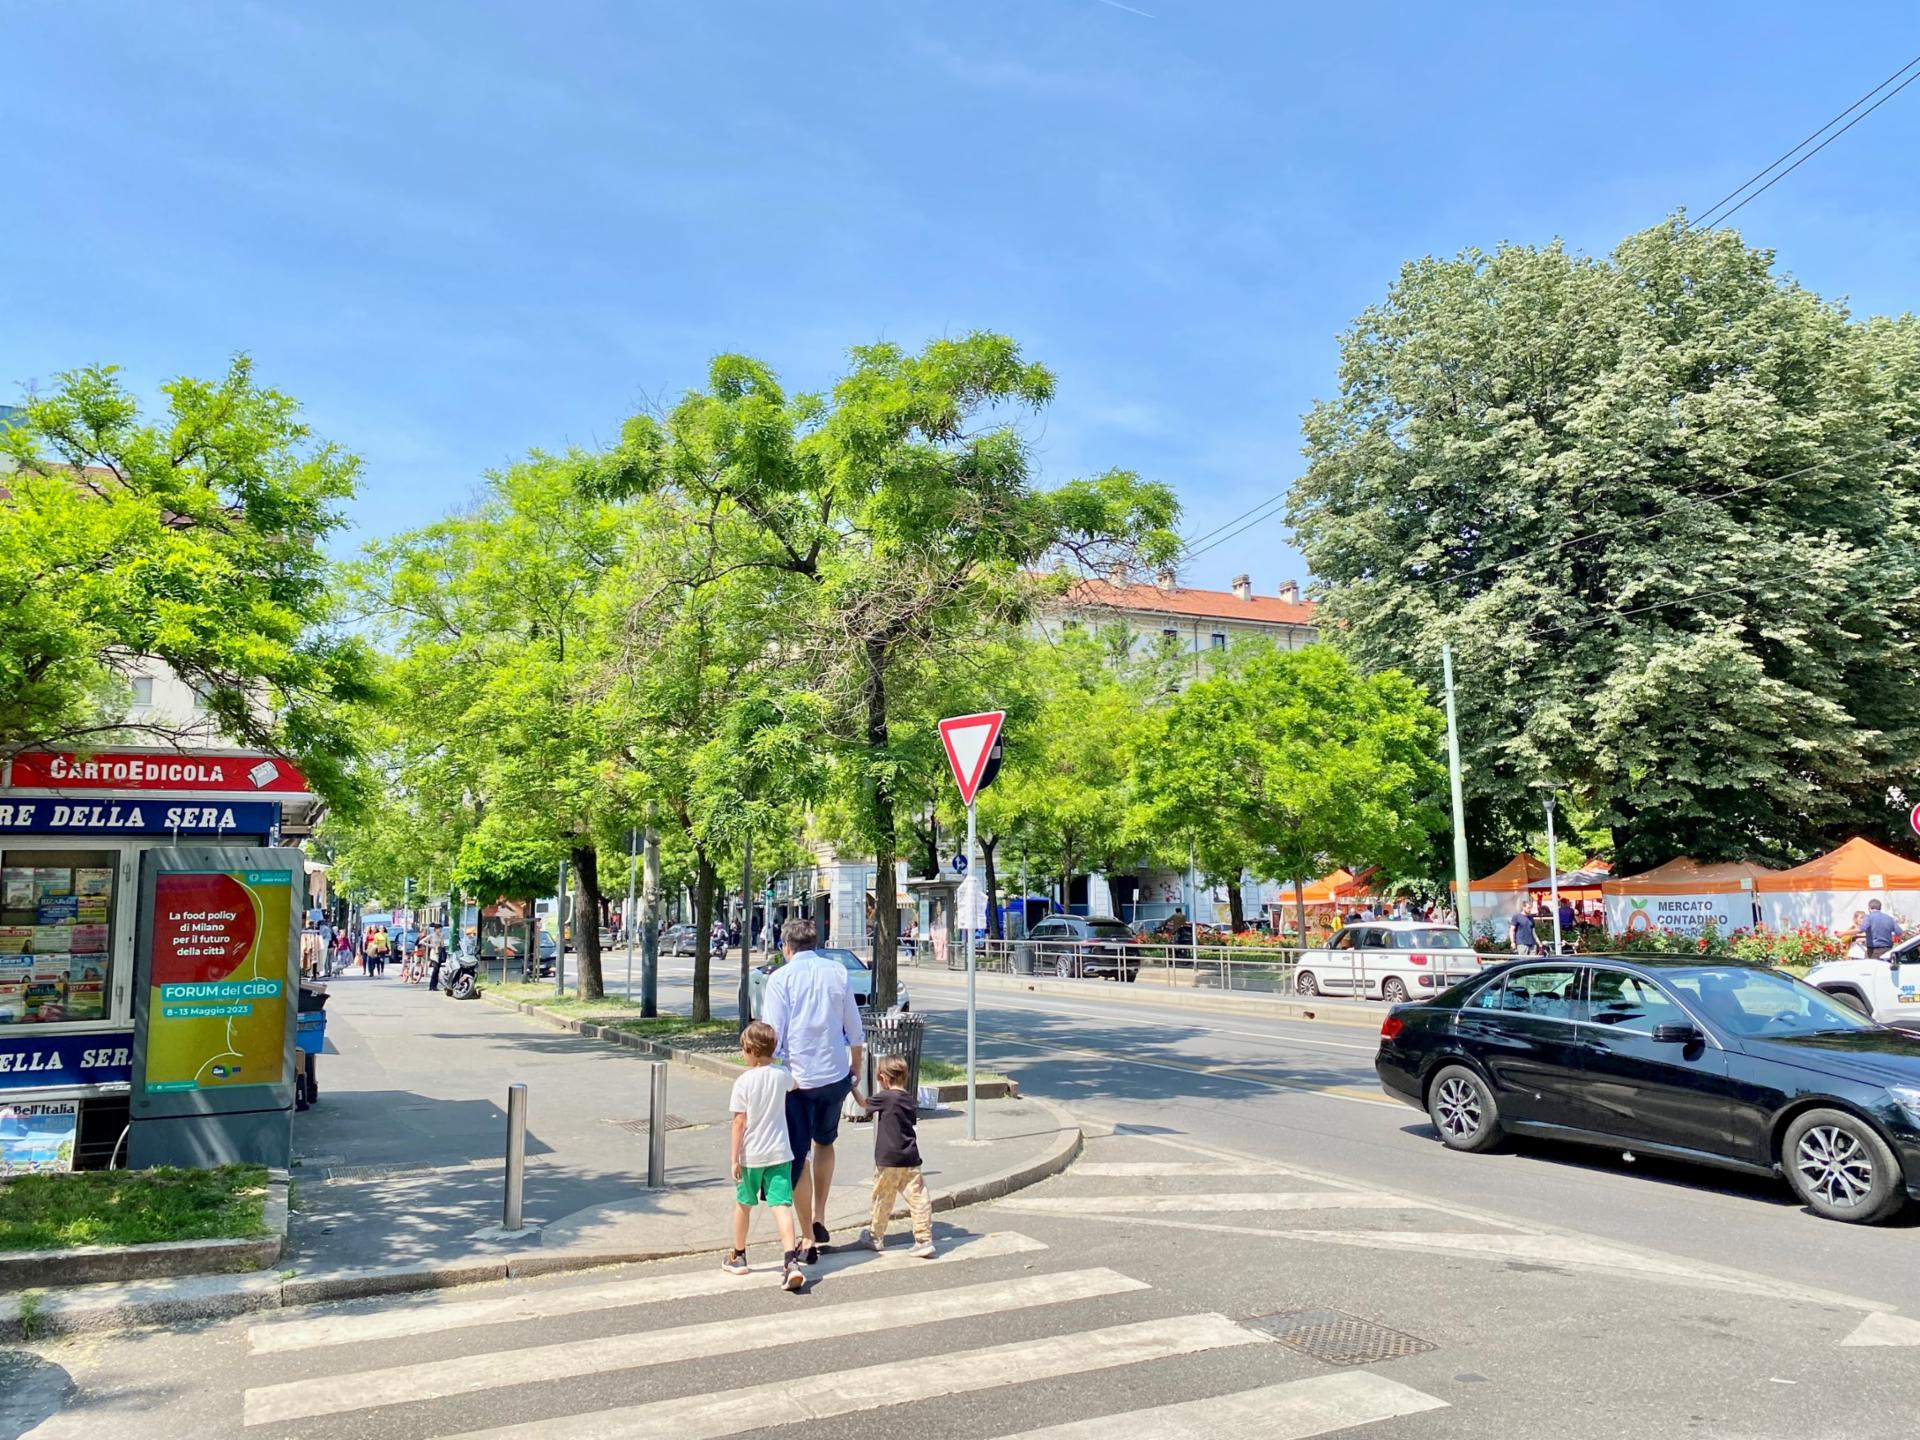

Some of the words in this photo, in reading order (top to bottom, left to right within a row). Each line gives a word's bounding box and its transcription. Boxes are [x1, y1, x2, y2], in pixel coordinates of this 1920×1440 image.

[0, 805, 36, 826] RE
[50, 805, 145, 827] DELLA
[164, 806, 237, 828] SERA
[1658, 901, 1713, 911] MERCATO
[169, 912, 181, 920] La
[183, 911, 206, 920] food
[207, 911, 237, 921] policy
[1657, 914, 1728, 925] CONTADINO
[180, 923, 190, 931] di
[192, 923, 225, 931] Milano
[172, 936, 189, 946] per
[191, 935, 198, 943] il
[199, 935, 230, 943] futuro
[176, 947, 201, 956] della
[202, 946, 225, 955] città
[165, 986, 219, 998] FORUM
[221, 986, 241, 996] del
[242, 983, 278, 995] CIBO
[190, 1006, 225, 1017] Maggio
[226, 1005, 248, 1014] 2023
[14, 1103, 75, 1115] Bell'Italia
